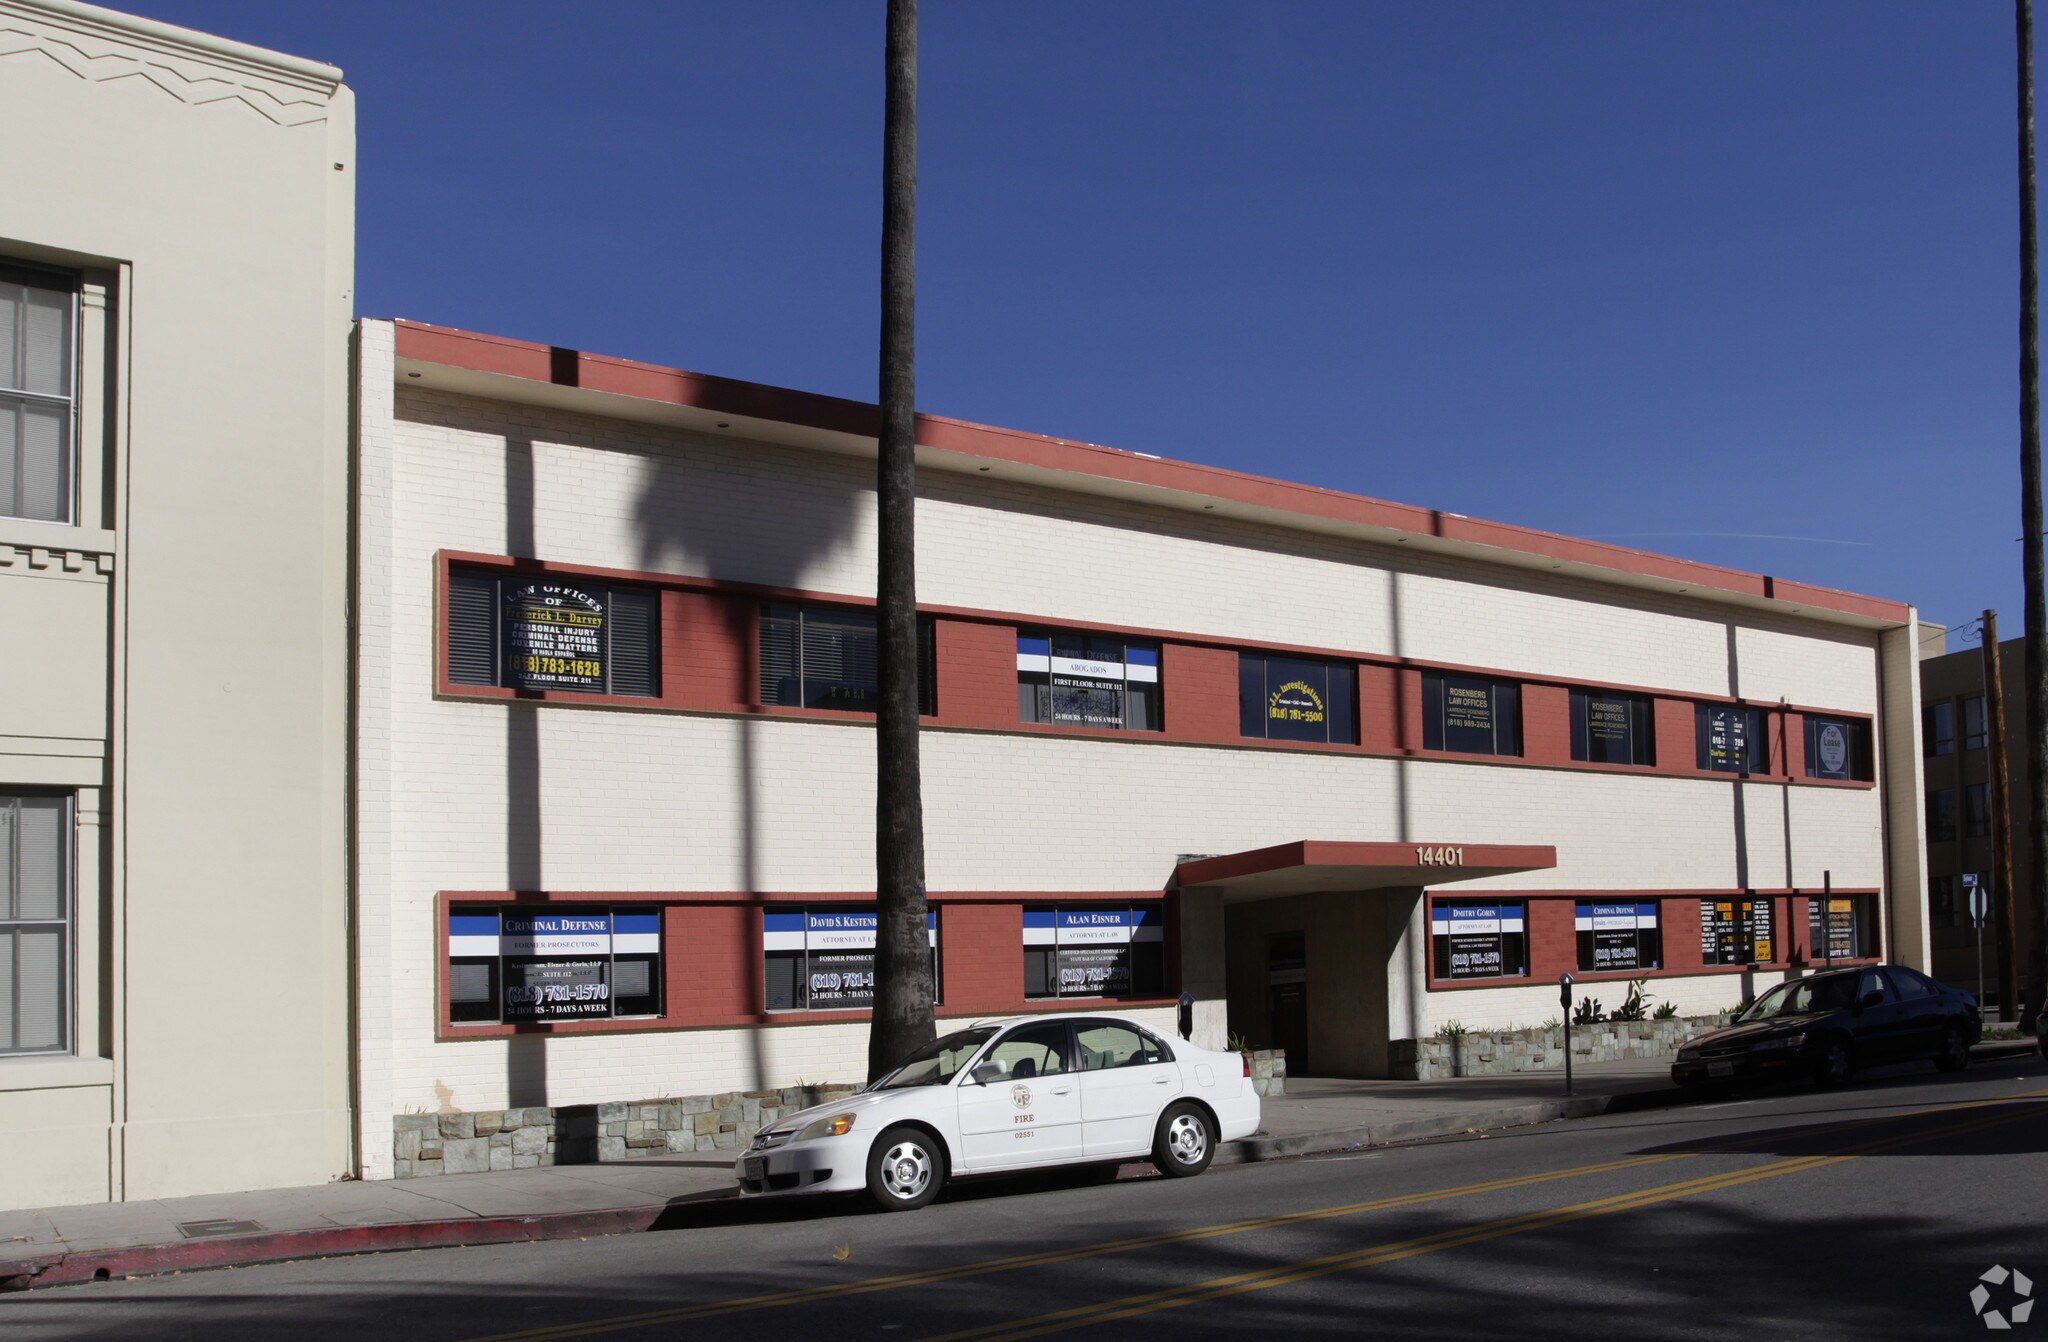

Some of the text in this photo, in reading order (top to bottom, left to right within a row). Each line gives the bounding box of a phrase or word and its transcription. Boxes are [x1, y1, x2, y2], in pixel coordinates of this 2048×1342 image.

[506, 585, 602, 612] LAW OFFICES
[545, 598, 563, 606] OF
[570, 613, 602, 627] Darvey
[514, 623, 595, 636] PERSONAL INJURY
[512, 631, 597, 644] CRIMINAL DEFENSE
[512, 639, 598, 652] JUVENILE MATTERS
[1070, 664, 1107, 673] ABOGADOS
[1055, 678, 1071, 686] FIRST
[1072, 679, 1095, 688] FLOOR:
[1096, 681, 1112, 689] SUITE
[1280, 681, 1323, 710] Investigations
[1450, 688, 1486, 698] ROSENBERG
[1463, 698, 1487, 707] OFFICES
[1592, 703, 1623, 712] ROSENBERG
[1061, 713, 1080, 721] HOURS
[1270, 707, 1323, 722] (818) 781-5500
[1604, 713, 1624, 721] OFFICES
[1448, 719, 1462, 727] (818)
[1827, 728, 1837, 737] For
[1824, 737, 1840, 747] Lease
[1417, 847, 1462, 865] 14401
[810, 917, 877, 927] DAVID S. KESTENB
[1067, 915, 1120, 924] ALAN EISNER
[506, 919, 606, 932] CRIMINAL DEFENSE
[810, 973, 874, 991] (818) 781-1
[1060, 969, 1085, 985] (818)
[507, 984, 608, 1005] (818) 781-1570
[517, 1006, 544, 1014] HOURS
[557, 1005, 577, 1013] DAYS
[584, 1004, 607, 1012] WEEK
[1015, 1114, 1034, 1123] FIRE
